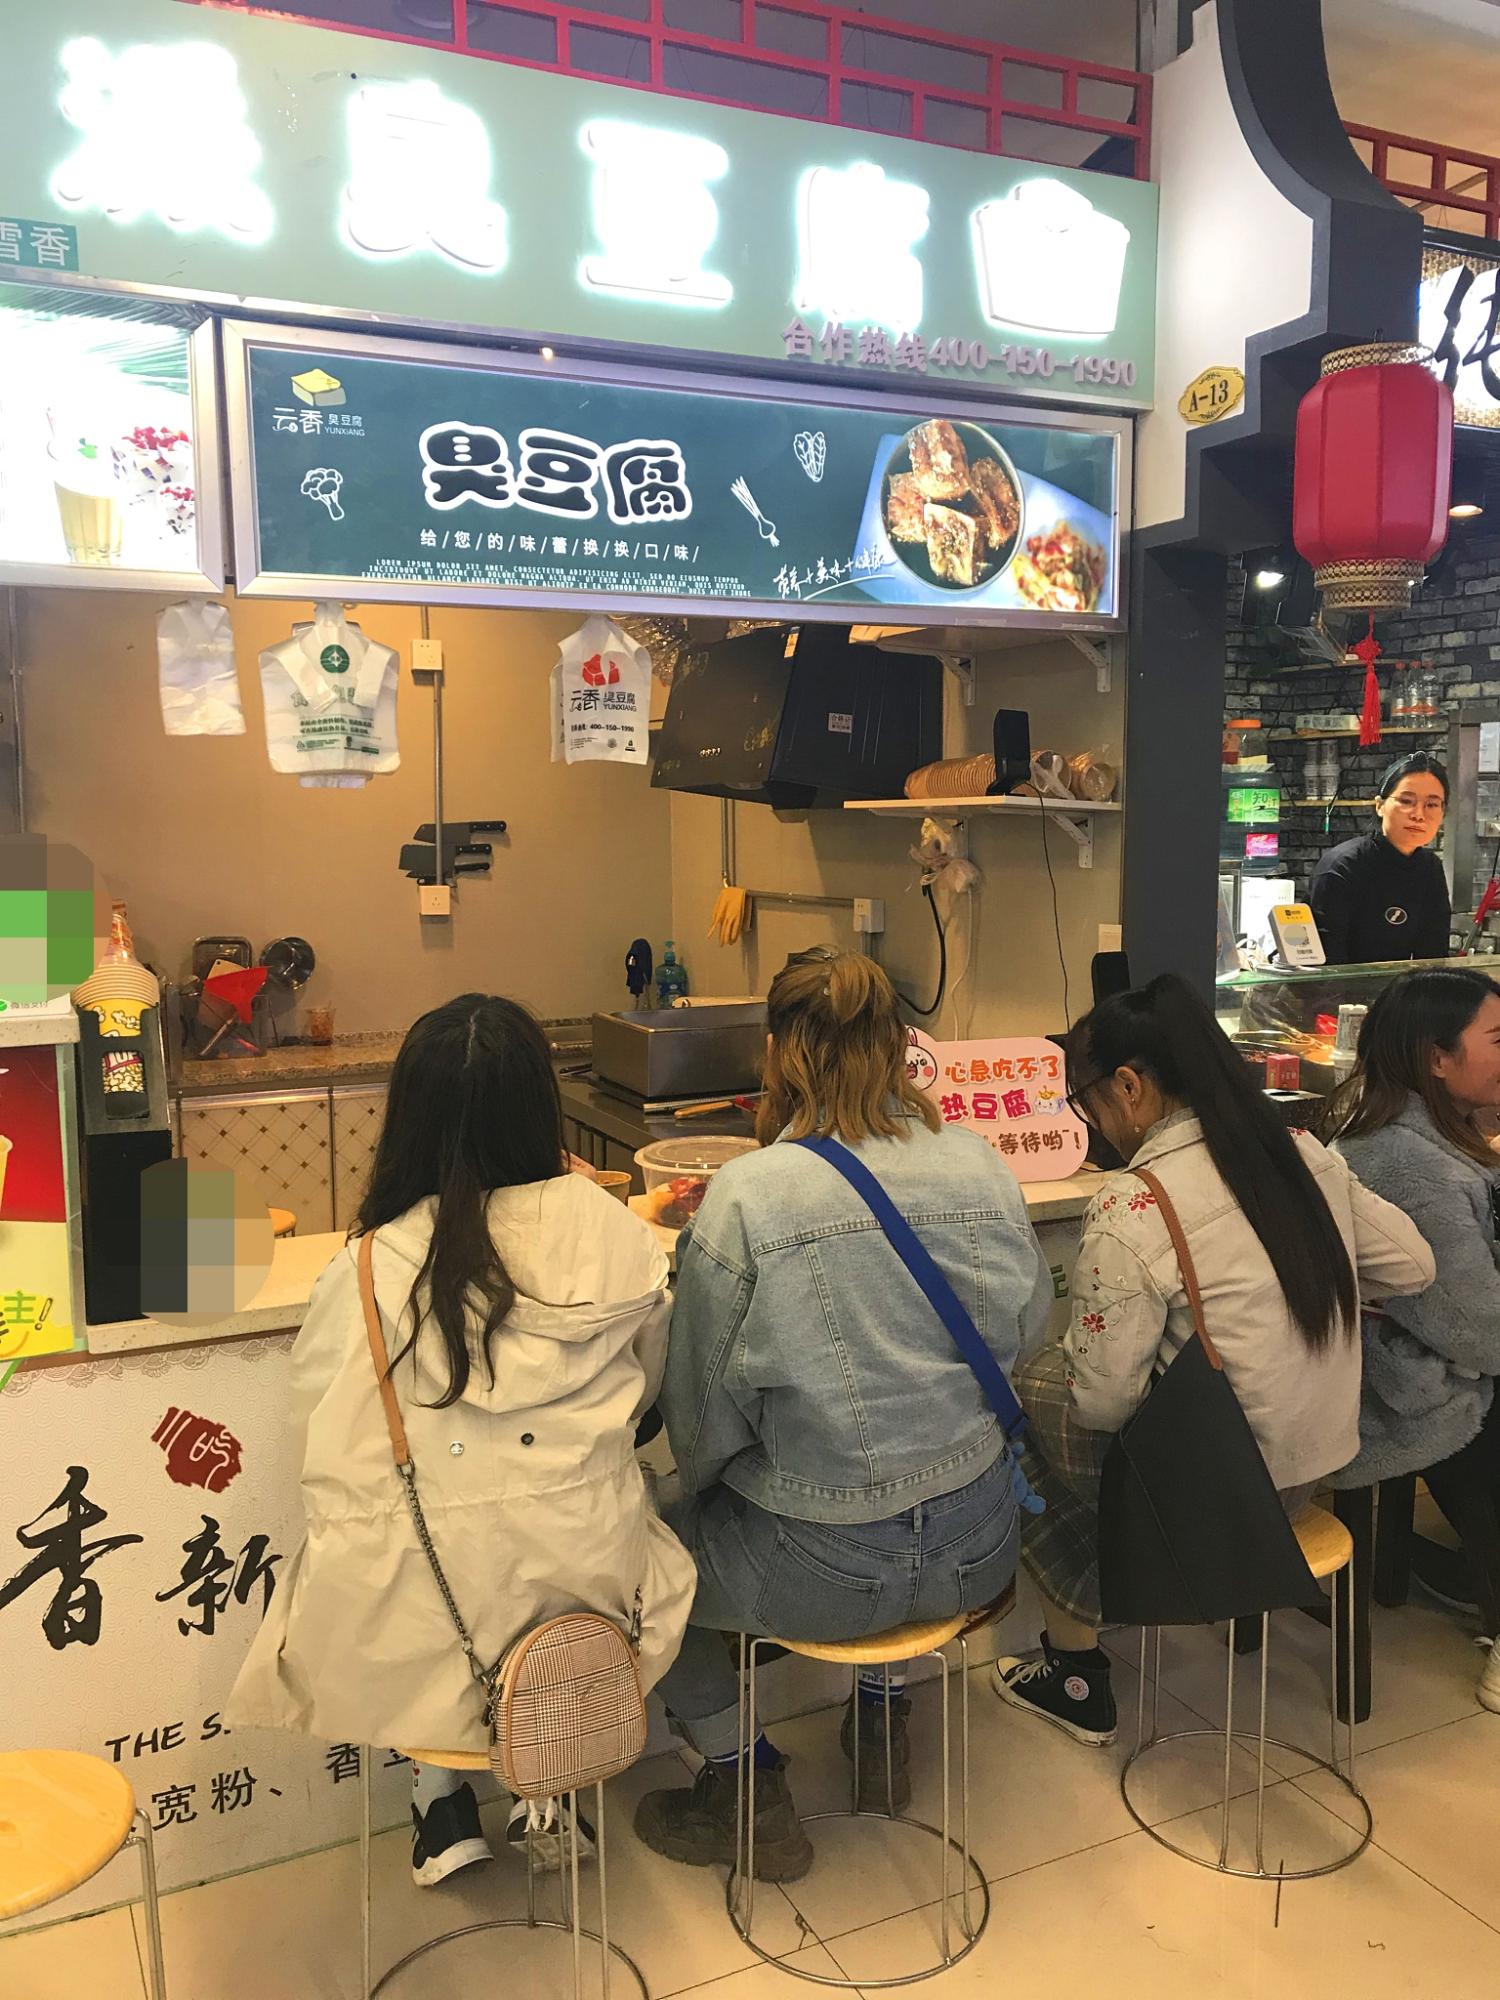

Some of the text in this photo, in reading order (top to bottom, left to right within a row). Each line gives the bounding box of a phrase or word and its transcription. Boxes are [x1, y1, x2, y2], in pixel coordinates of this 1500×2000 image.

[1189, 379, 1228, 412] A-13
[419, 420, 693, 526] 臭豆腐
[945, 1055, 1059, 1085] 心急吃不了
[939, 1088, 1031, 1122] 热豆腐
[104, 1721, 186, 1762] THE
